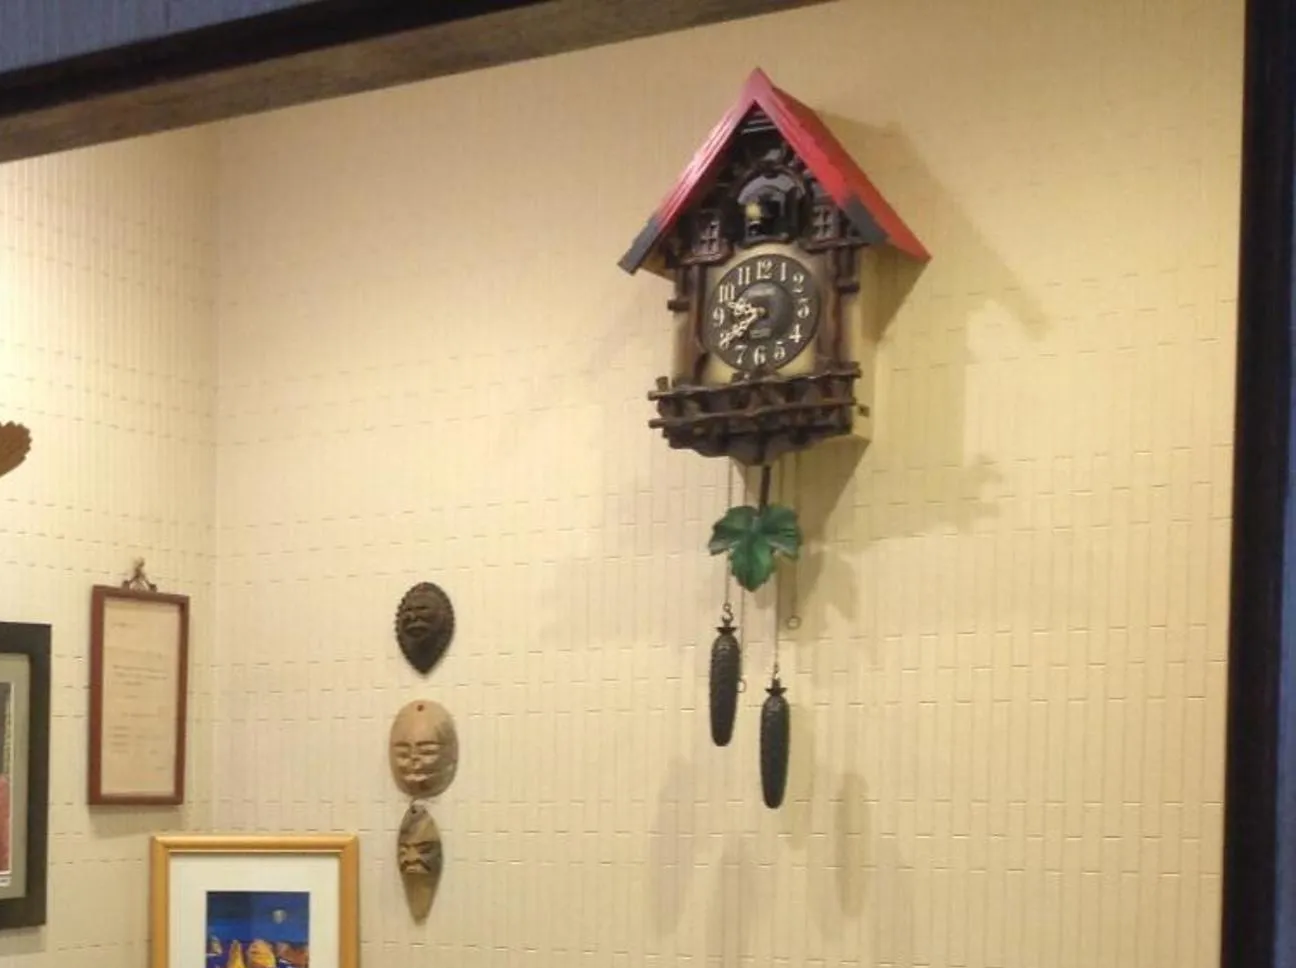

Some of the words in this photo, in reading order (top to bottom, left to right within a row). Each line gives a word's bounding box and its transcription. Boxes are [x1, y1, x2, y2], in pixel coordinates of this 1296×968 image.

[737, 266, 751, 286] 11
[756, 259, 772, 280] 12
[719, 282, 736, 303] 10
[792, 272, 805, 294] 2
[712, 307, 725, 328] 9
[797, 297, 810, 319] 3
[789, 323, 803, 343] 4
[735, 344, 748, 365] 7
[753, 344, 766, 365] 6
[772, 340, 786, 361] 5
